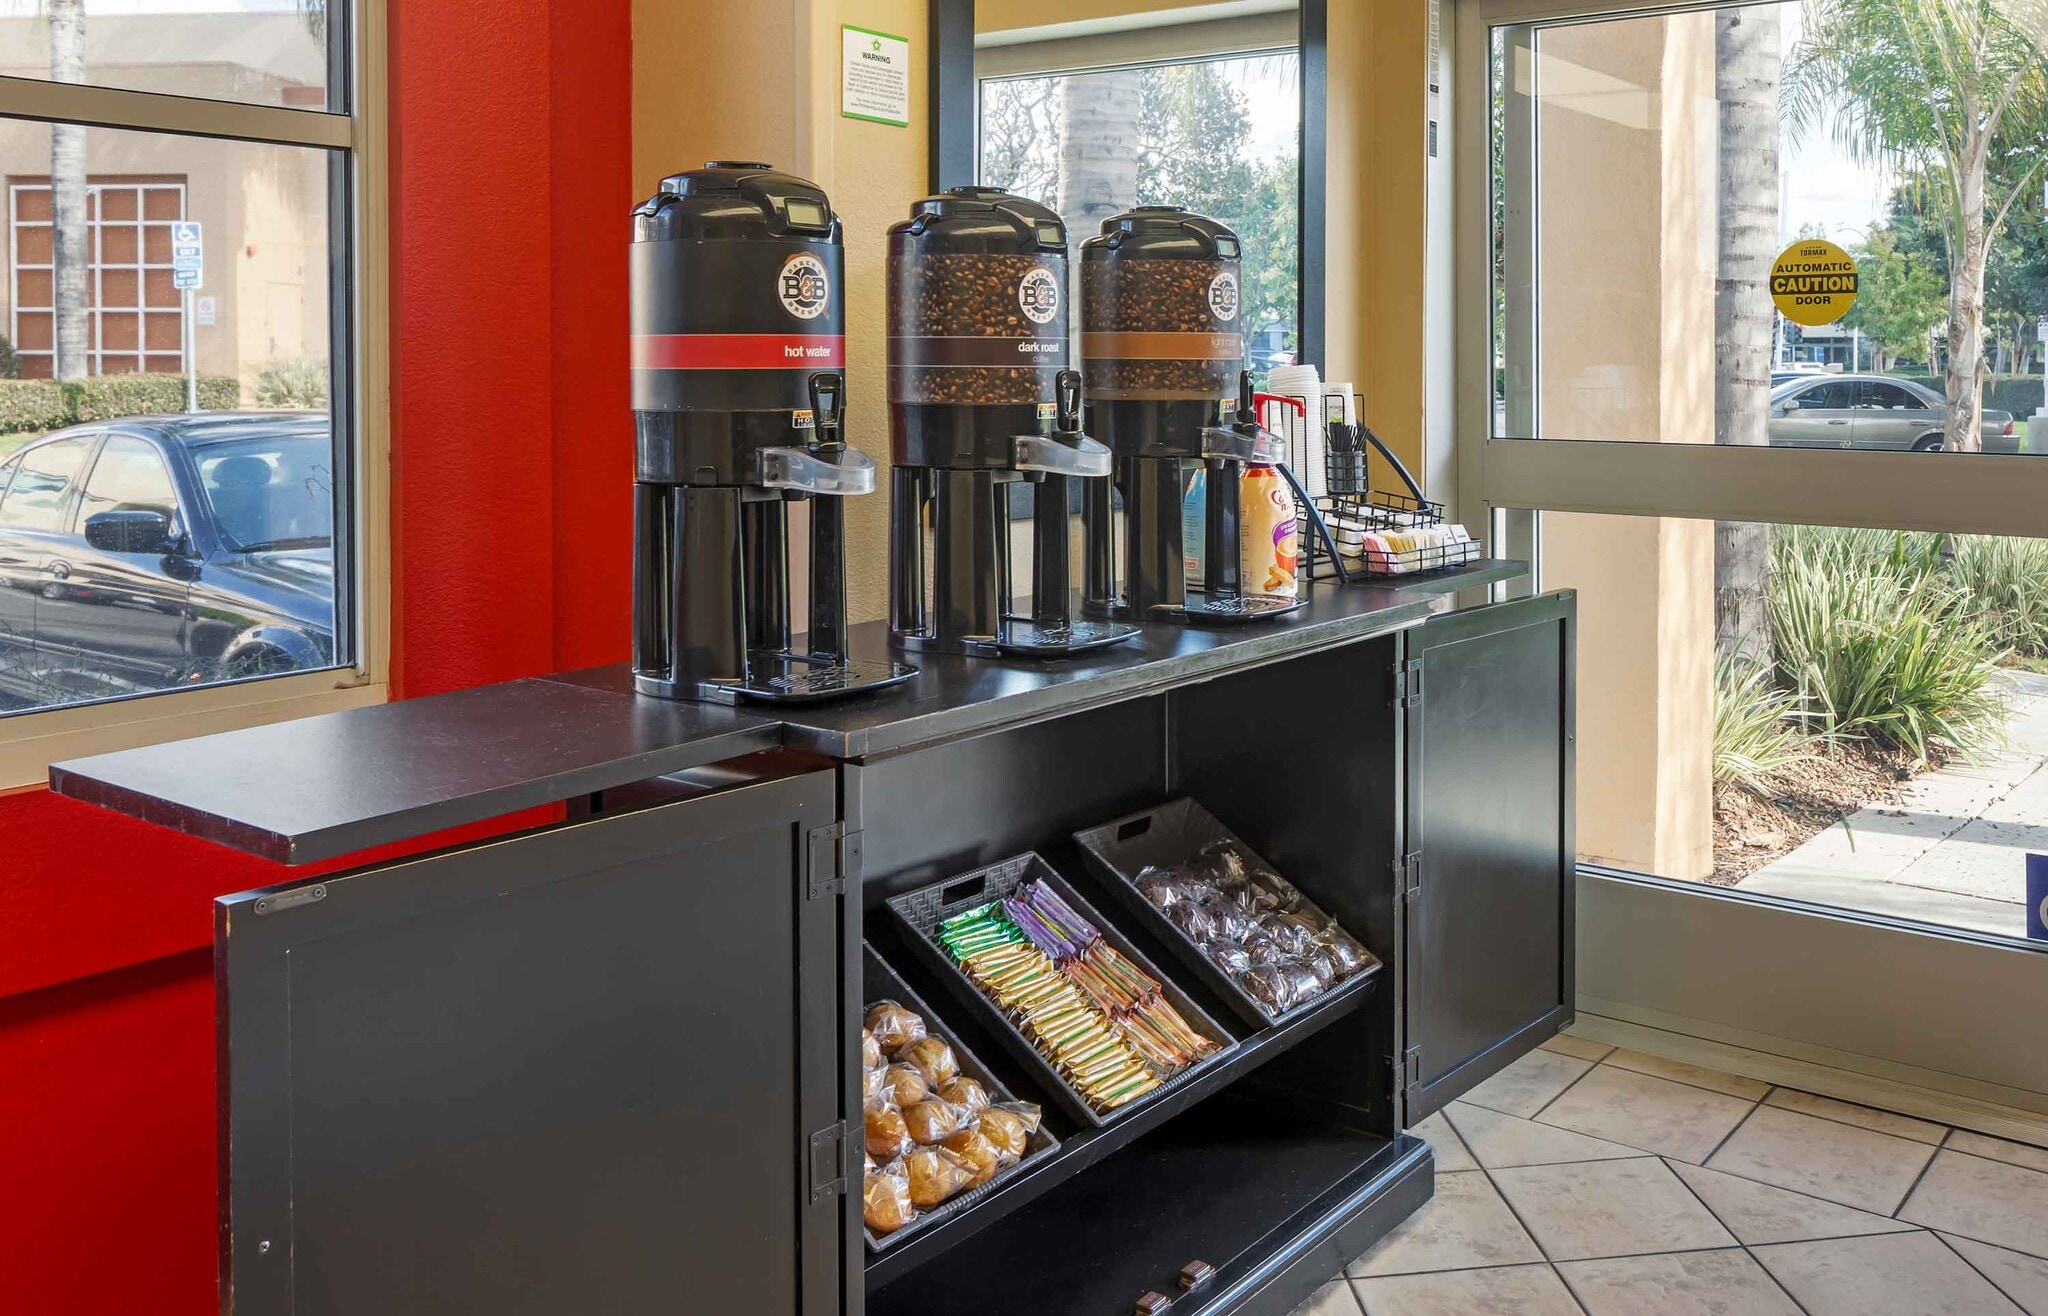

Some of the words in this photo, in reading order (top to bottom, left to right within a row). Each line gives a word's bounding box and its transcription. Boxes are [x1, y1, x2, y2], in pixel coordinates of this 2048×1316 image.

[862, 52, 891, 64] WARNING
[1776, 262, 1852, 273] AUTOMATIC
[783, 275, 826, 301] B&B
[1773, 276, 1854, 292] CAUTION
[1022, 285, 1056, 307] B&B
[1795, 296, 1831, 305] DOOR
[784, 345, 804, 357] hot
[806, 346, 831, 357] water
[1018, 341, 1040, 352] dark
[1041, 342, 1060, 352] roast
